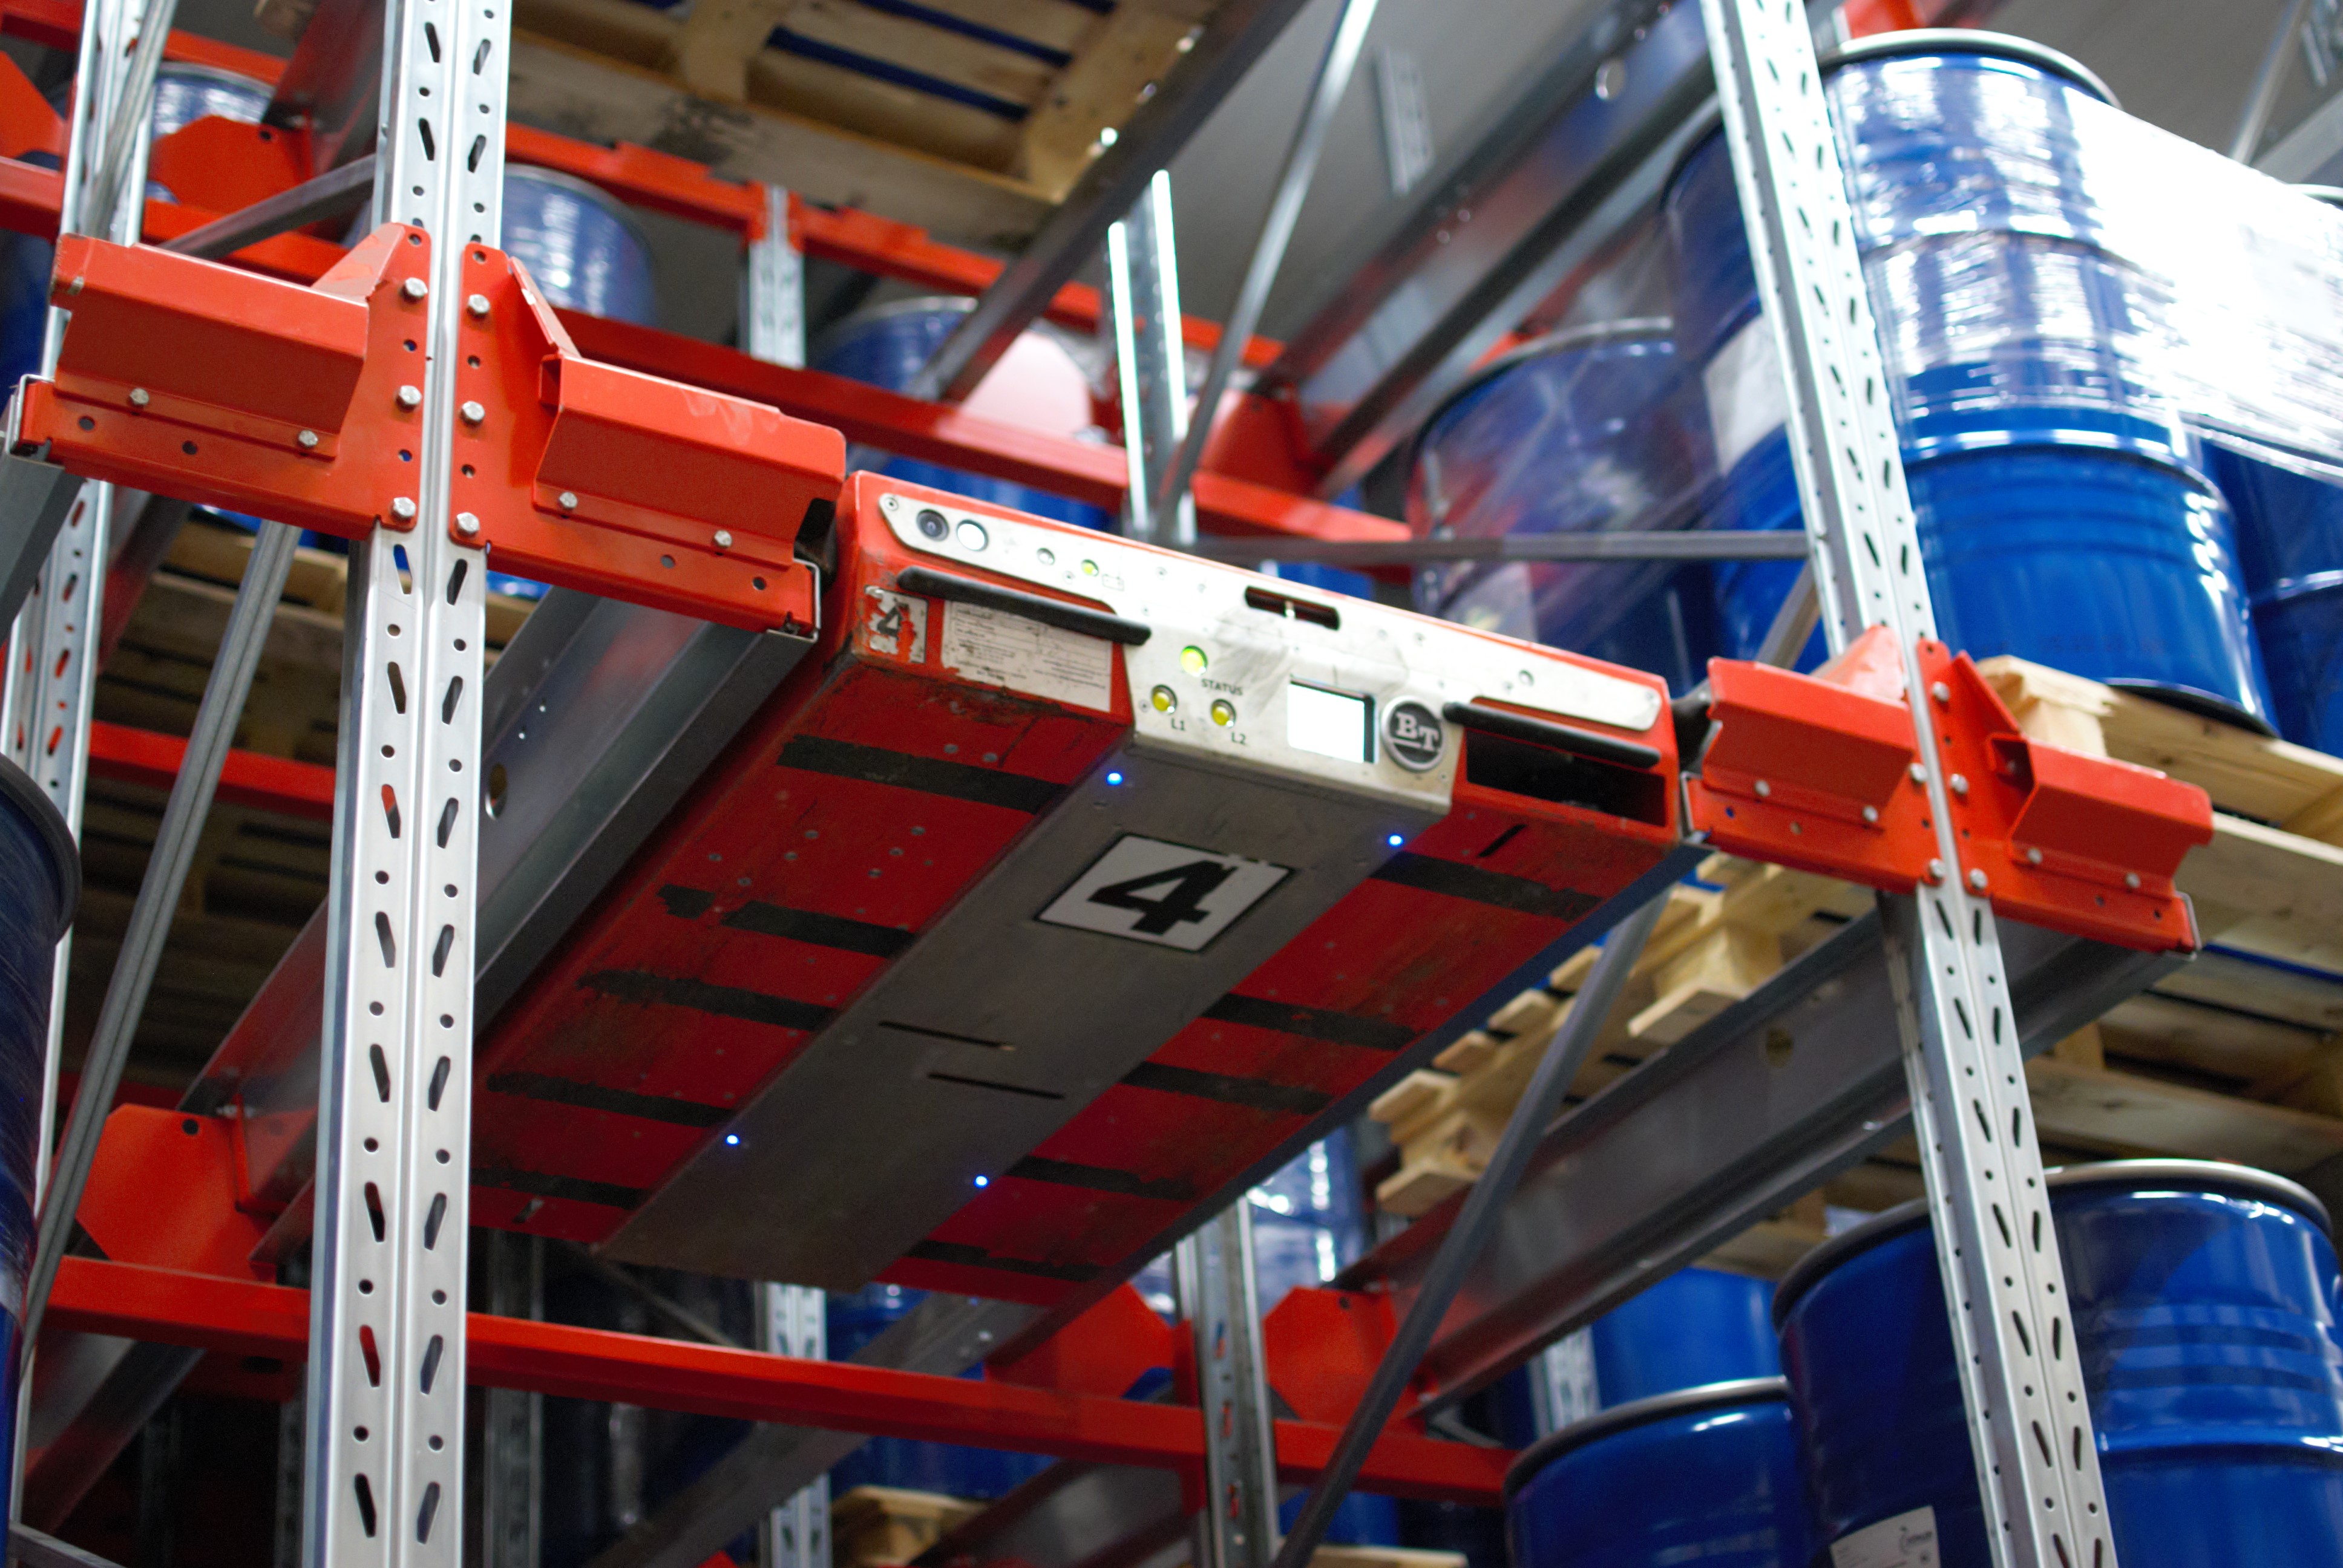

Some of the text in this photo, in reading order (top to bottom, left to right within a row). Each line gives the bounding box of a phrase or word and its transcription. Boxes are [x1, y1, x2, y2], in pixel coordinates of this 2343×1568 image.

[1201, 678, 1244, 696] STATUS
[1171, 718, 1185, 731] L1
[1396, 712, 1439, 751] BT
[1231, 731, 1247, 745] L2
[1087, 860, 1239, 935] 4
